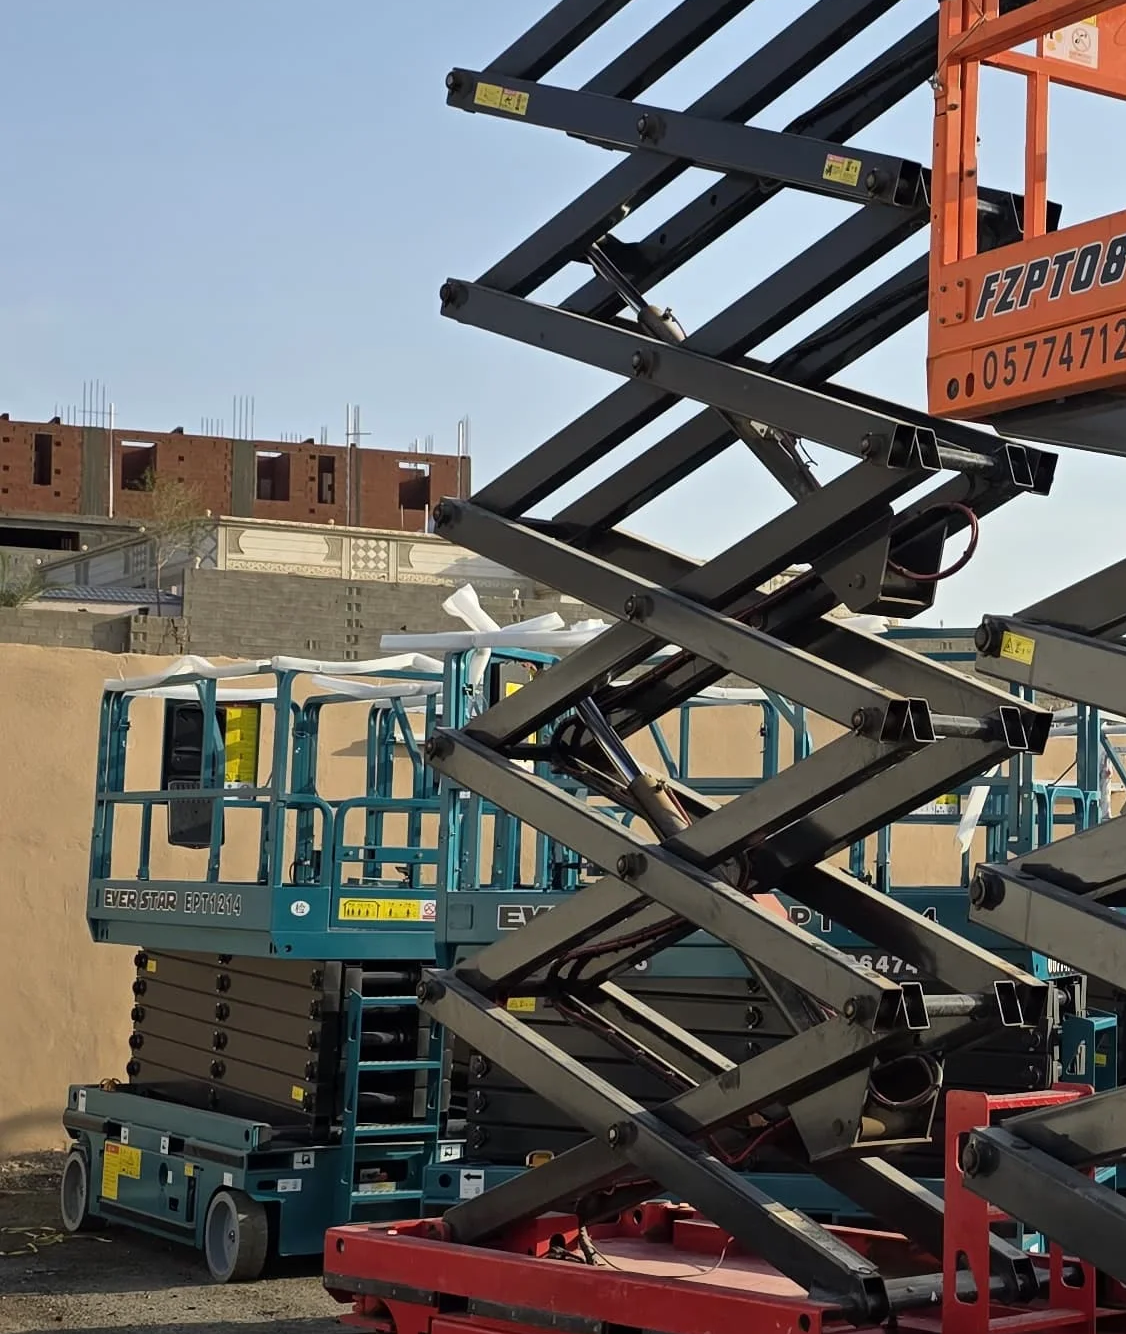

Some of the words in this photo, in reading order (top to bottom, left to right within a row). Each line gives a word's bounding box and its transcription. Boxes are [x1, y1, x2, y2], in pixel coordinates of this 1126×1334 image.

[104, 888, 137, 910] EVER
[139, 890, 177, 912] STAR
[184, 891, 241, 917] EPT1214
